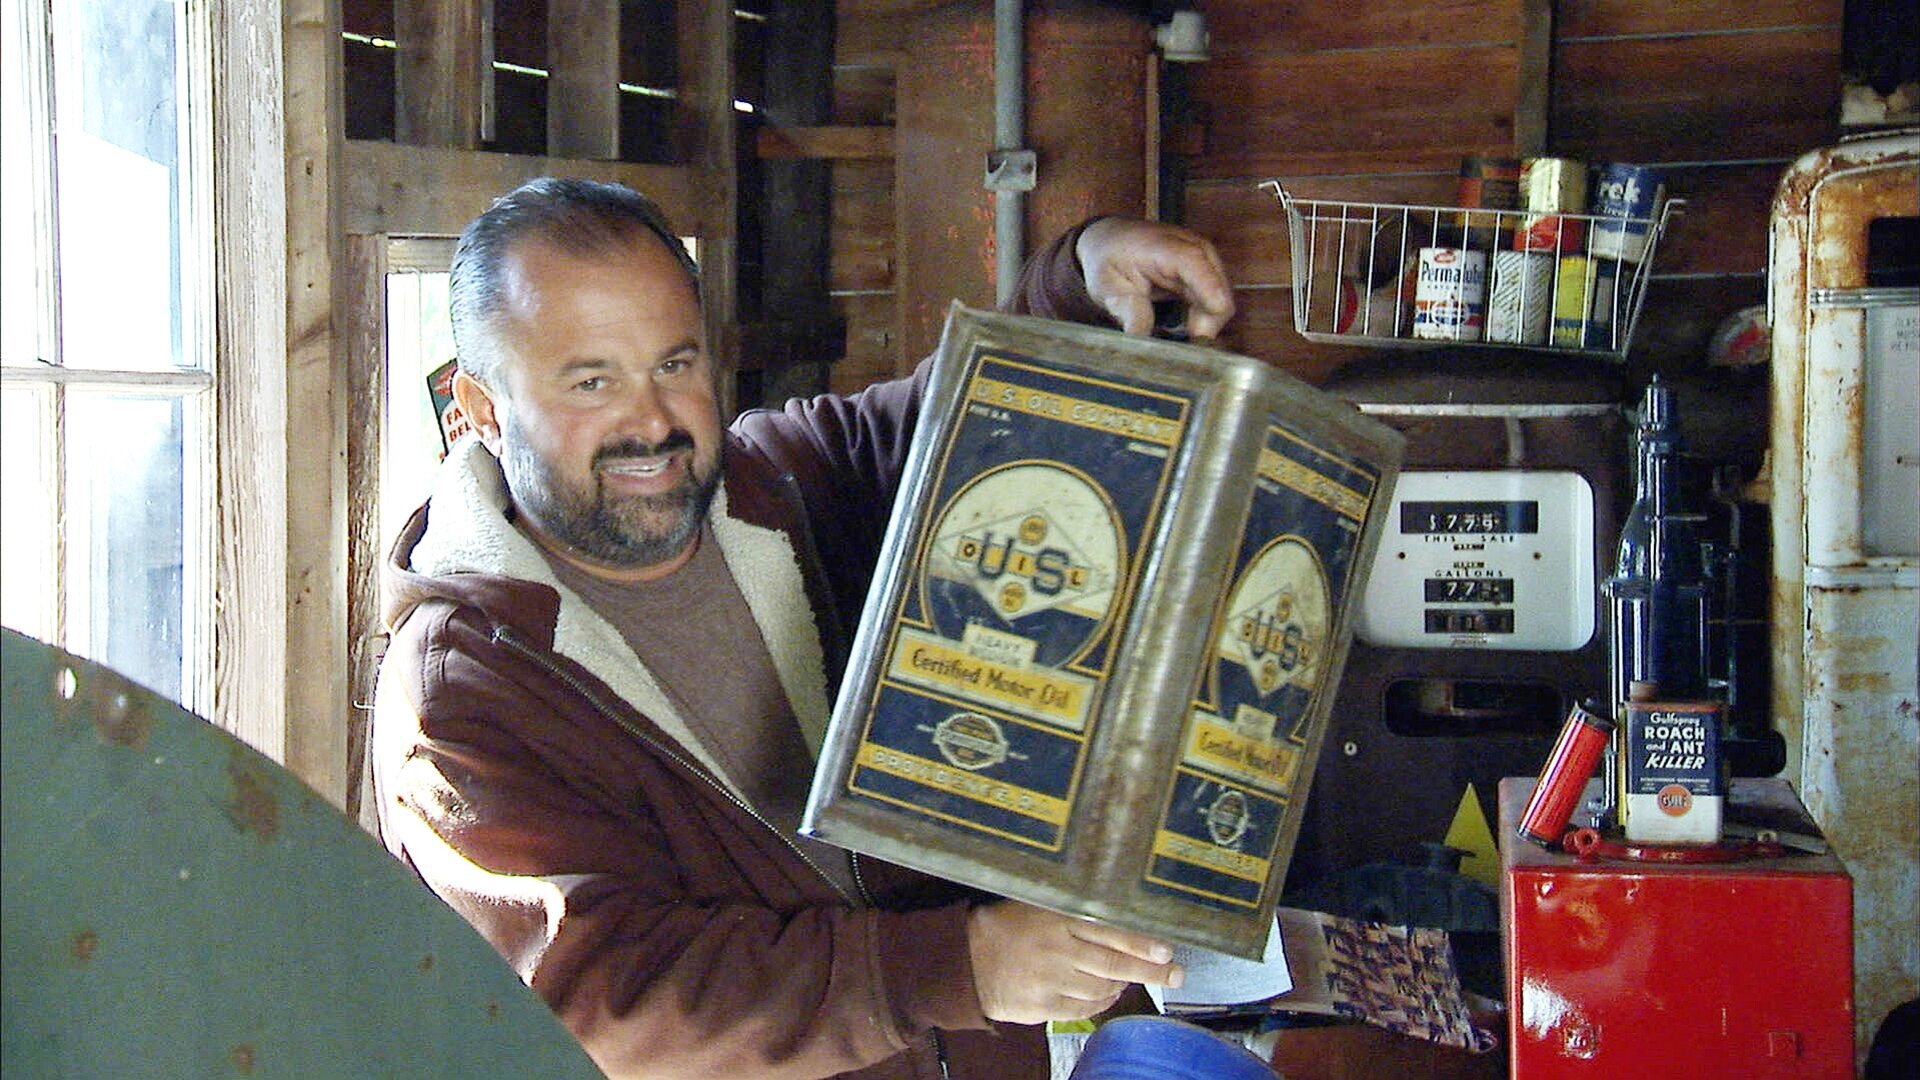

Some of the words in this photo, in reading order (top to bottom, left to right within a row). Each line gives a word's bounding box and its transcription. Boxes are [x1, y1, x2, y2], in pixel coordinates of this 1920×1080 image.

[446, 407, 464, 426] FA
[1425, 535, 1456, 543] THIS
[1481, 535, 1514, 543] SALE
[1435, 569, 1503, 578] GALLONS
[911, 647, 982, 685] Certified
[985, 663, 1035, 699] Motor
[1038, 682, 1069, 708] Oil
[1644, 725, 1705, 740] ROACH
[1645, 740, 1667, 751] and
[1669, 740, 1706, 754] ANT
[1644, 752, 1706, 770] KILLER
[1661, 793, 1688, 807] GULF
